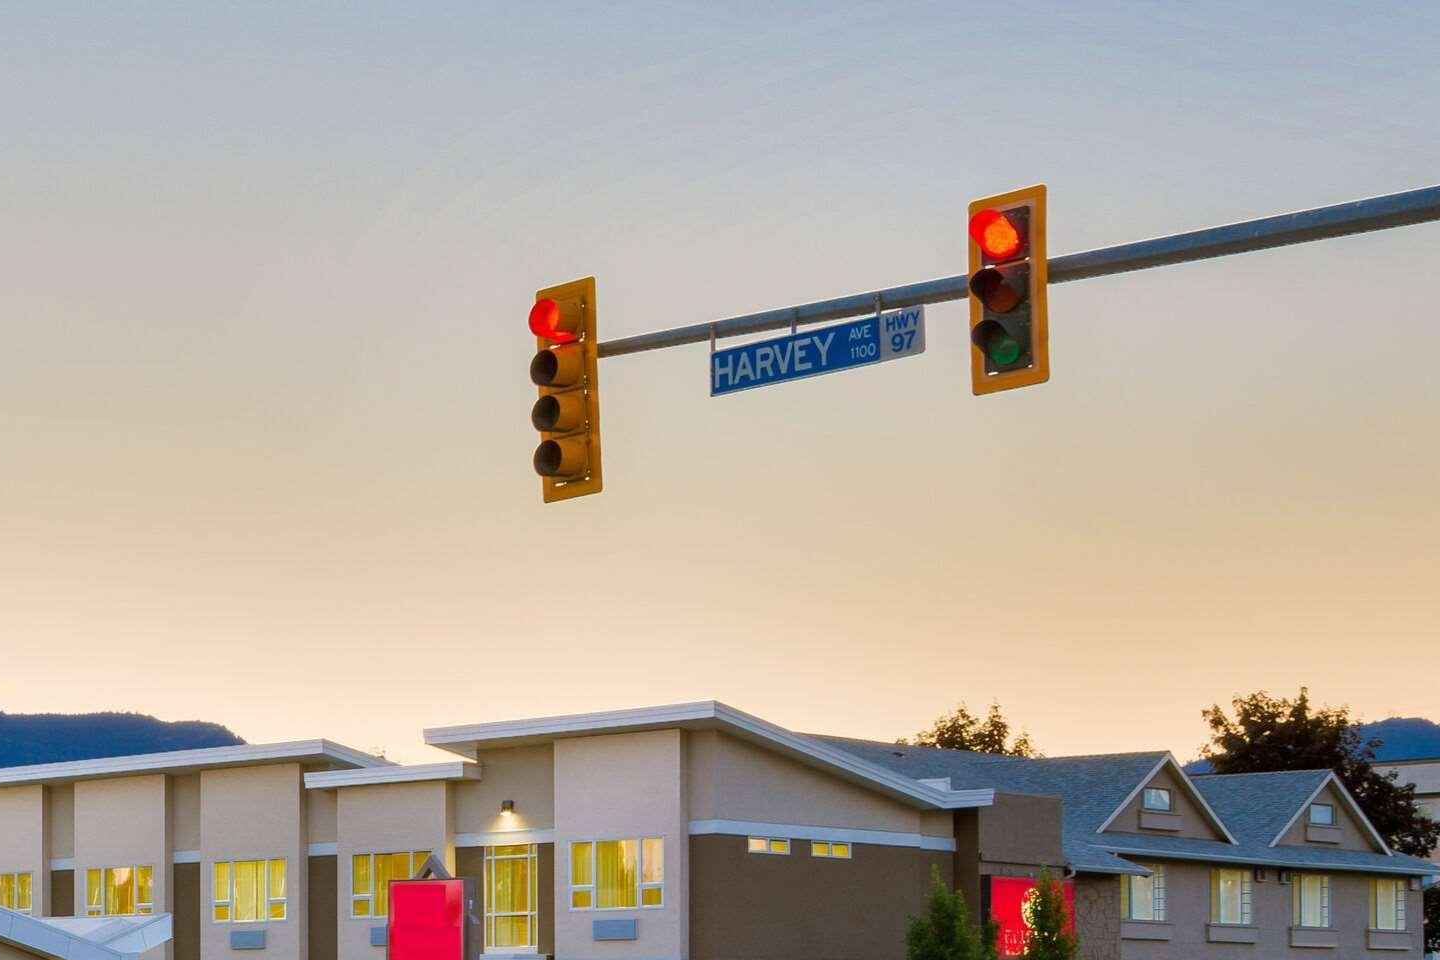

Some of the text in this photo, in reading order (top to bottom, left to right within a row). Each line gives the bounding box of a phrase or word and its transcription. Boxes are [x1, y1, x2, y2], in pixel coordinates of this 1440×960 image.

[885, 310, 921, 333] HWY
[850, 344, 877, 360] 1100
[891, 330, 917, 353] 97
[714, 324, 872, 388] HARVEY AVE
